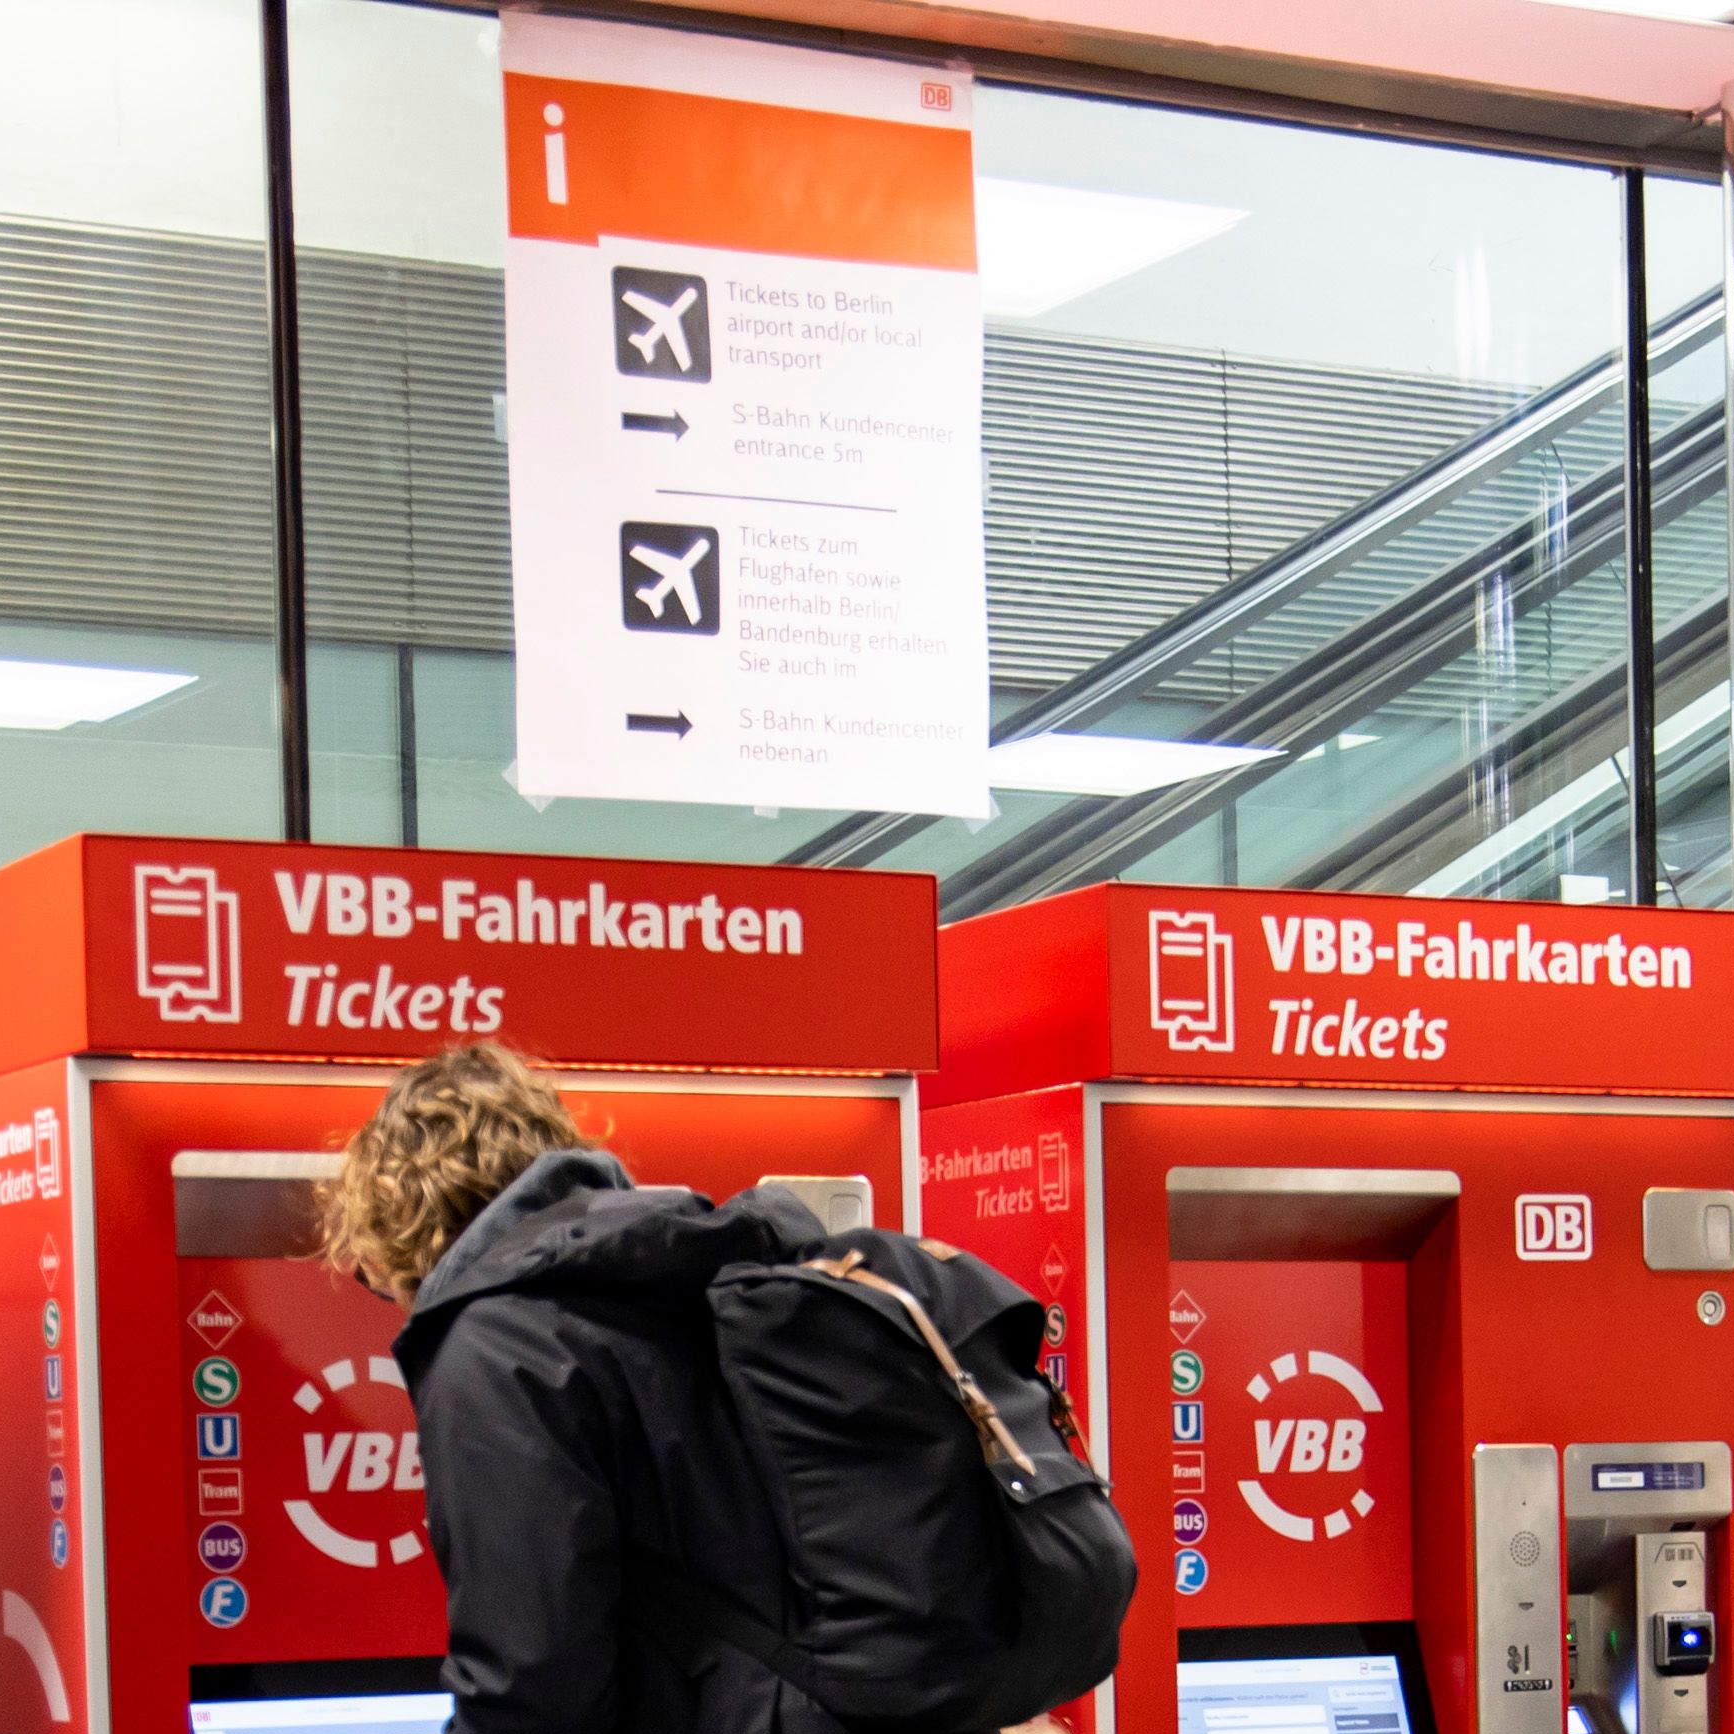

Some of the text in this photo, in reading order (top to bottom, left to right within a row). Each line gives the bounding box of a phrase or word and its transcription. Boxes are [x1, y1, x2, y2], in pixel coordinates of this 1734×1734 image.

[726, 280, 893, 315] Tickets to Berlin
[726, 313, 922, 349] airport and/or local
[728, 344, 822, 371] transport
[732, 403, 955, 445] S-Bahn Kundencenter
[733, 436, 825, 462] entrance
[739, 526, 858, 556] Tickets zum
[739, 557, 901, 590] Flughafen sowie
[738, 589, 900, 624] innerhalb Berlin/
[868, 631, 948, 655] erhalten
[738, 650, 858, 678] Sie auch im
[739, 708, 964, 741] S-Bahn Kundencenter
[739, 741, 829, 764] nebenan
[275, 870, 805, 957] VBB-Fahrkarten
[1261, 914, 1693, 990] VBB-Fahrkarten
[283, 963, 505, 1035] Tickets
[1269, 998, 1449, 1061] Tickets
[975, 1184, 1034, 1219] Tickets
[1525, 1207, 1583, 1251] DB
[196, 1313, 234, 1328] Bahn
[202, 1365, 232, 1400] S
[1173, 1356, 1197, 1387] S
[204, 1419, 234, 1454] U
[1175, 1406, 1198, 1439] U
[1255, 1418, 1367, 1474] VBB
[202, 1483, 239, 1499] Tram
[204, 1538, 242, 1557] BUS
